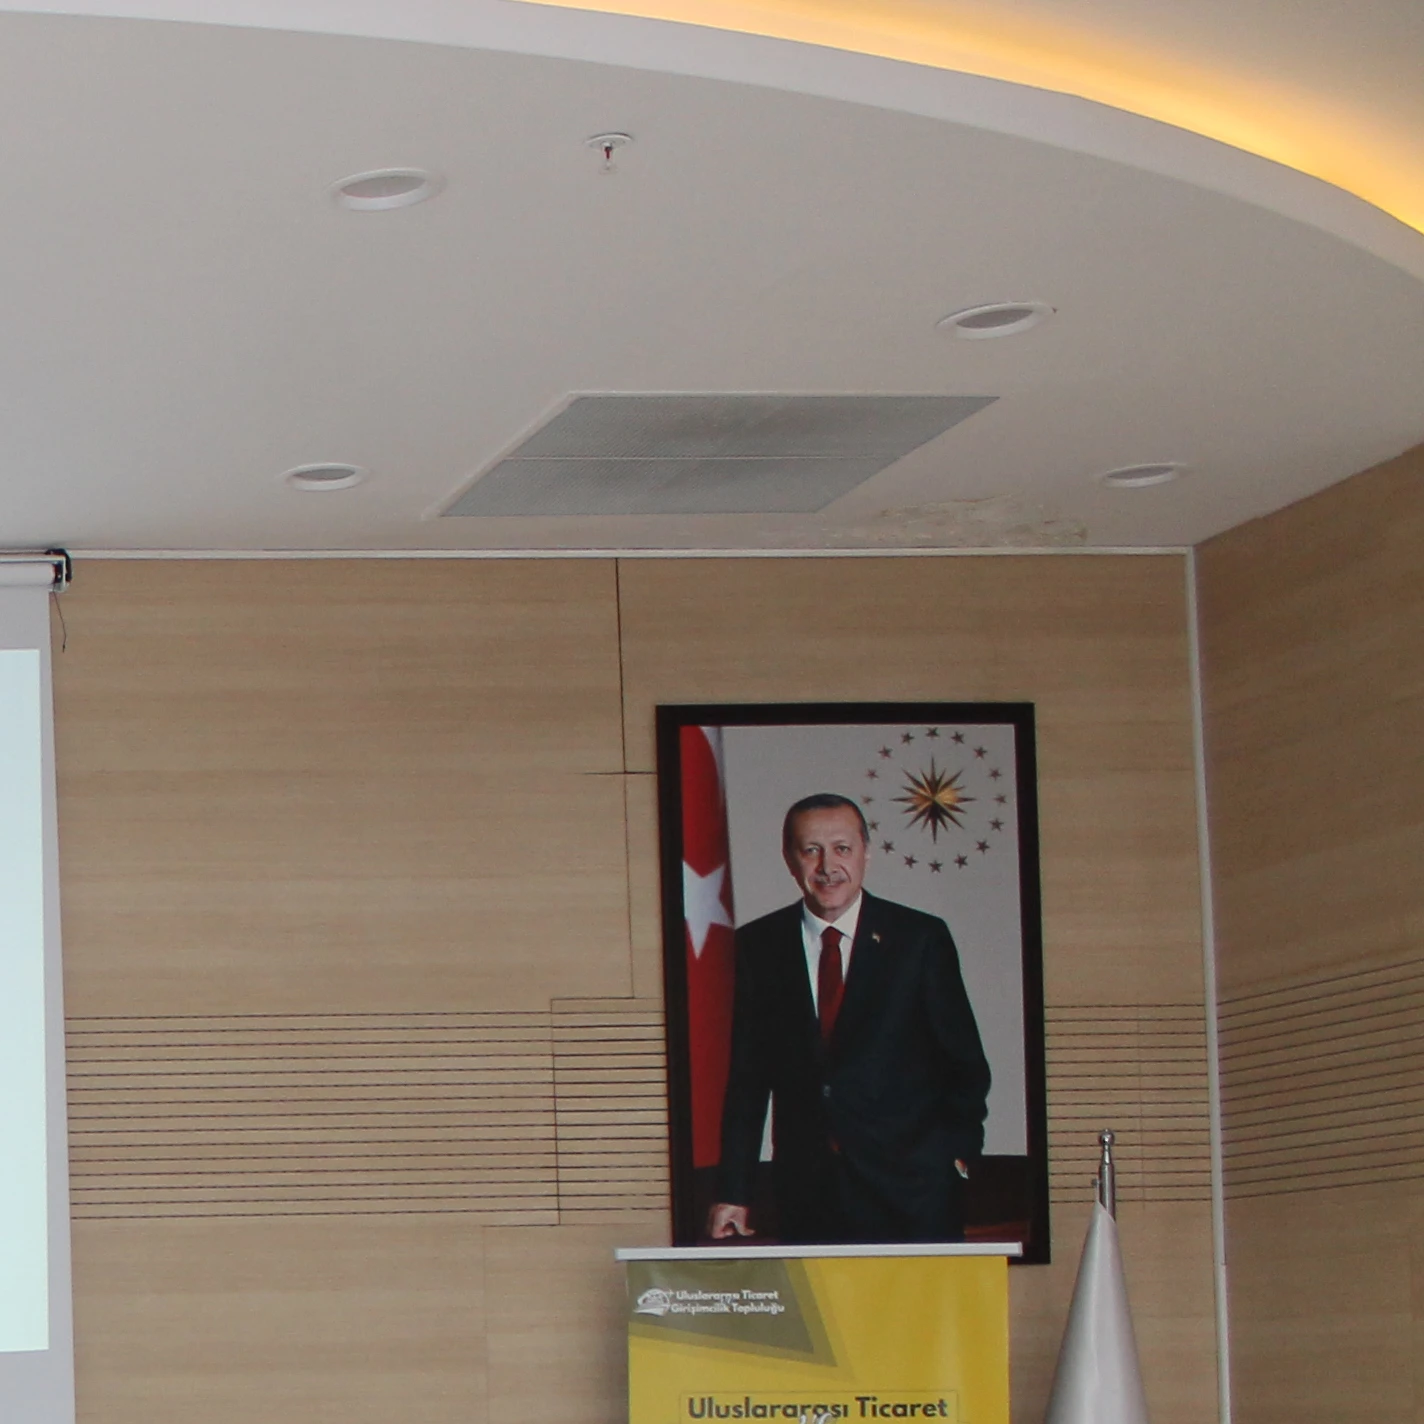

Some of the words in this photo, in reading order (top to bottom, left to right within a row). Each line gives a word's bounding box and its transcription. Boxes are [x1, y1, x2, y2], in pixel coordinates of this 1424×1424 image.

[741, 1288, 779, 1300] Ticaret
[732, 1302, 785, 1315] Topluluğu
[687, 1396, 848, 1419] Uluslararası
[854, 1395, 948, 1419] Ticaret
